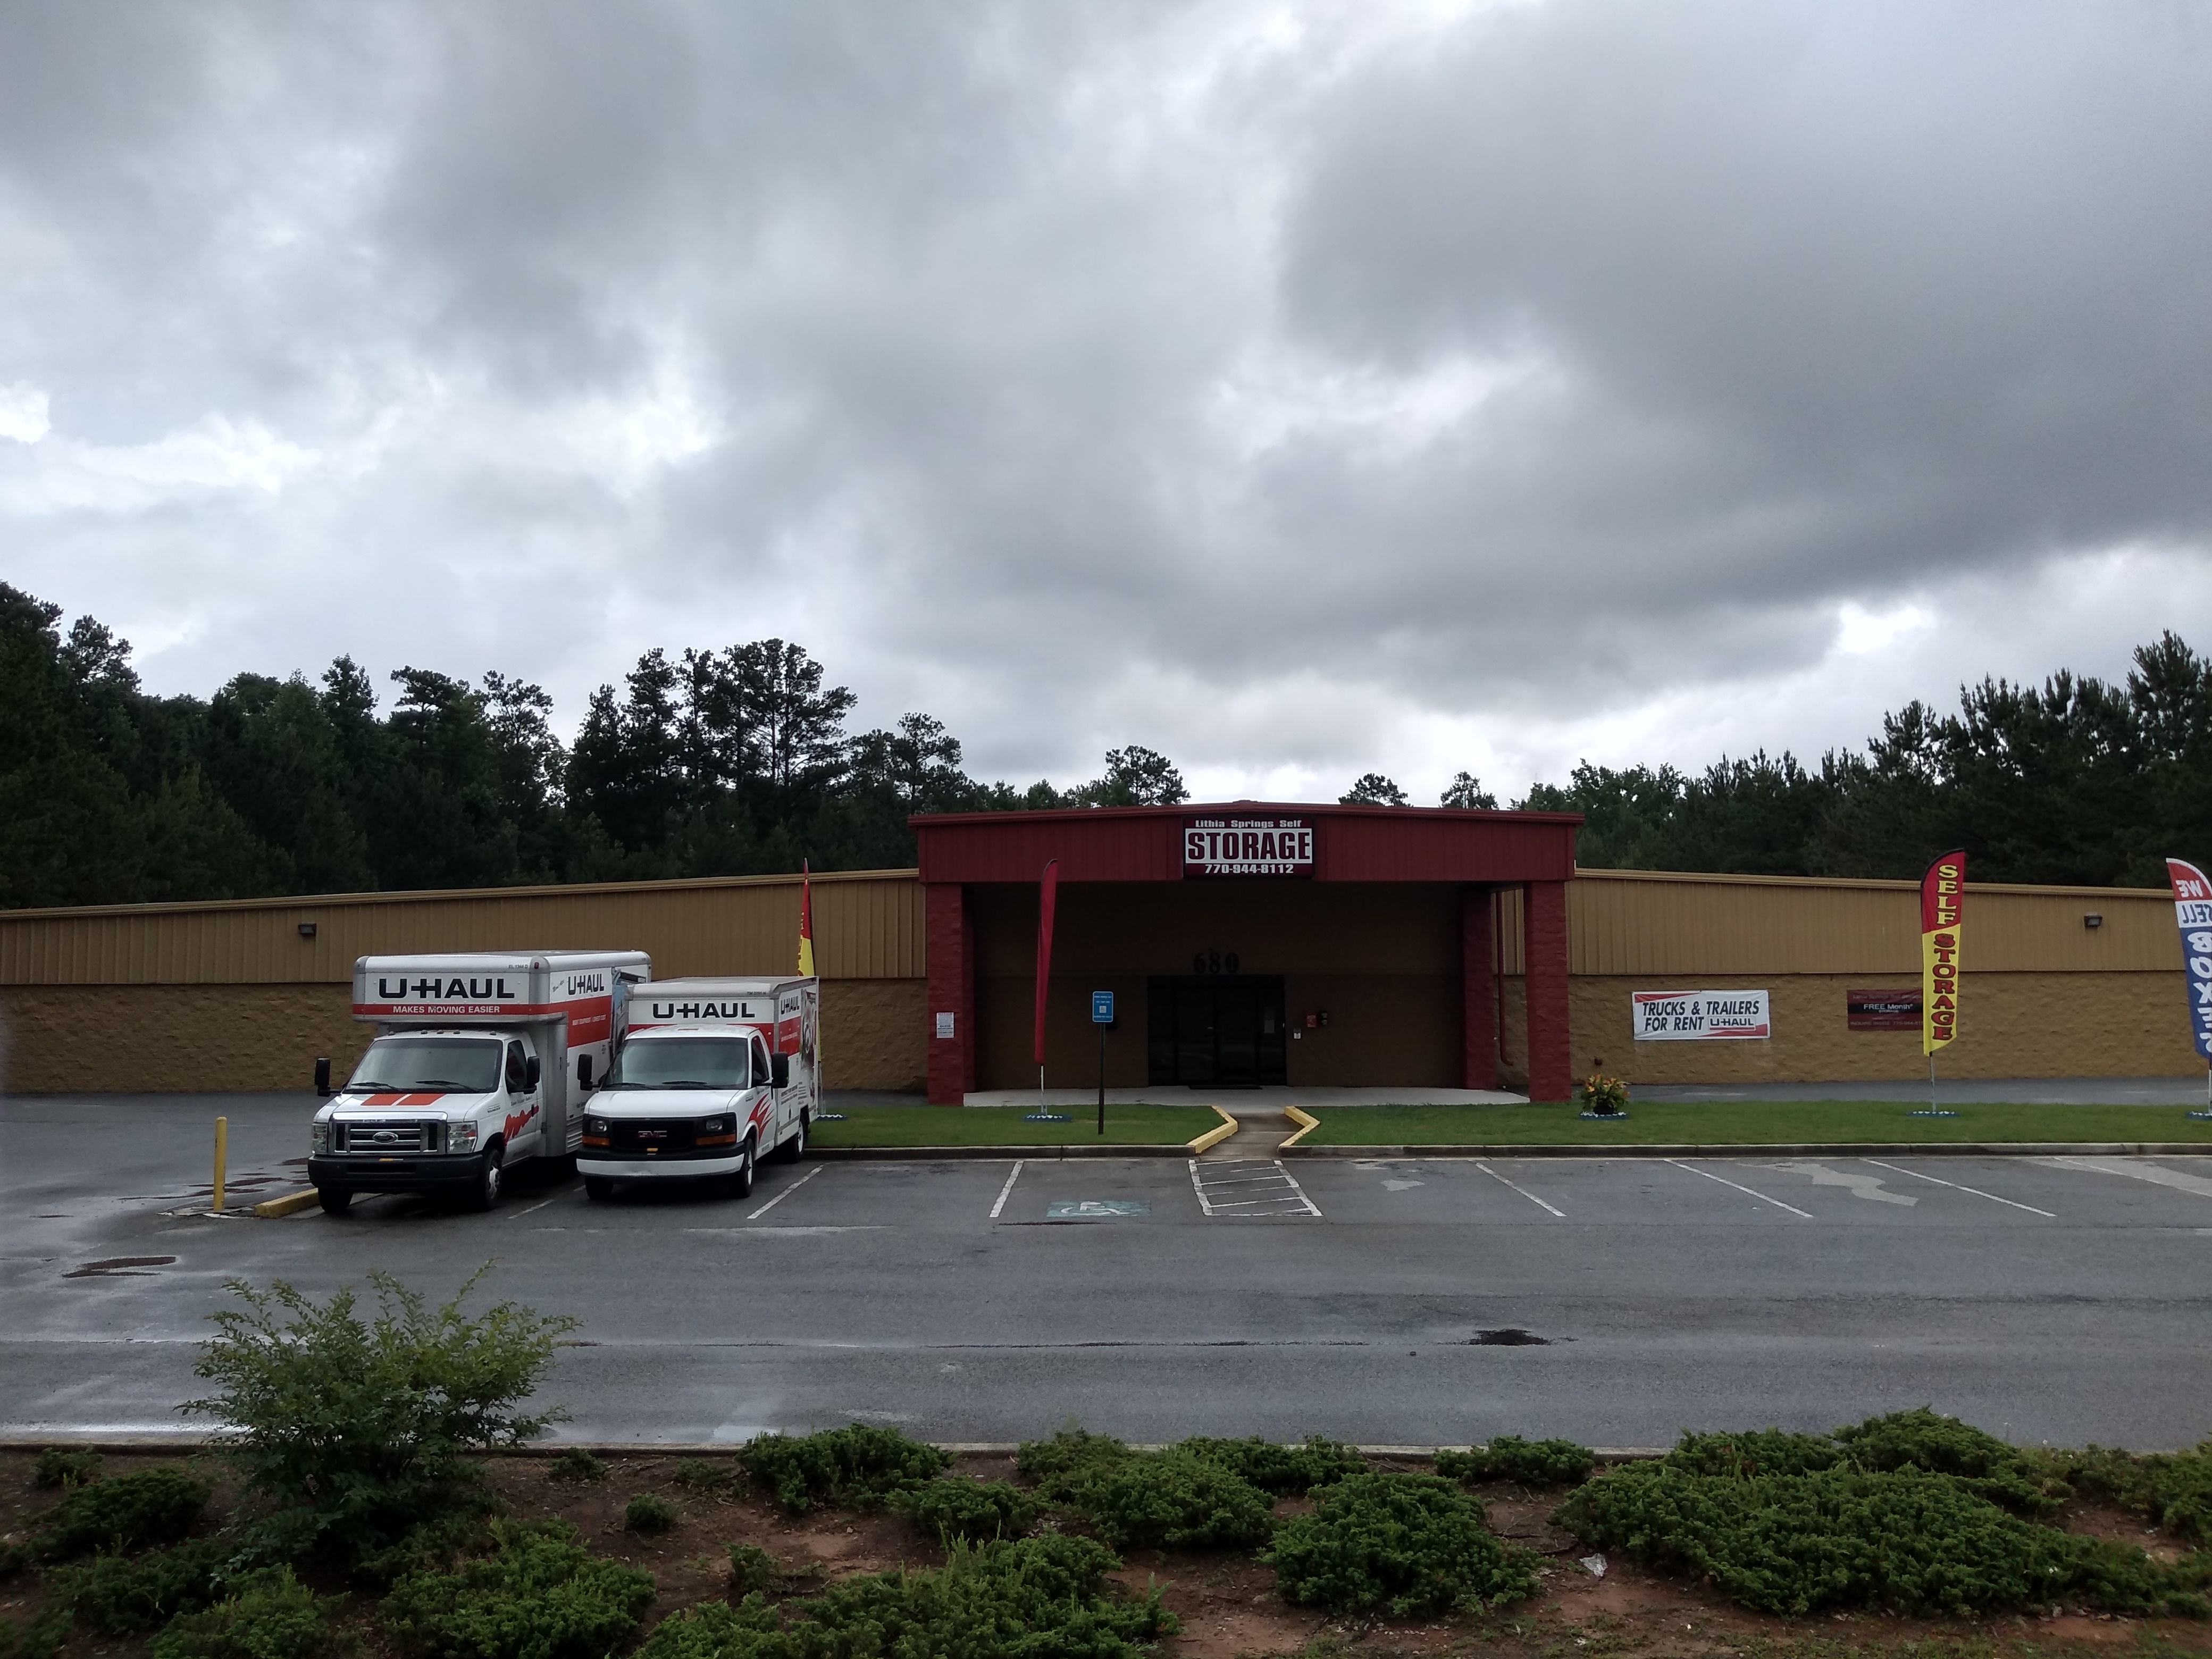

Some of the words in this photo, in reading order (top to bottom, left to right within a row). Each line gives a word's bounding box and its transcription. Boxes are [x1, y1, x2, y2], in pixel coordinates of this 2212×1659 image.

[1230, 820, 1274, 829] Springs
[1188, 832, 1311, 860] STORAGE
[1204, 864, 1294, 874] 770-944-8112
[1937, 865, 1959, 925] SELF
[1194, 952, 1239, 974] 680
[379, 978, 515, 999] U-HAUL
[568, 973, 605, 995] U-HAUL
[1931, 933, 1956, 1041] STORAGE
[652, 1002, 755, 1019] U-HAUL
[780, 995, 800, 1015] U-HAUL
[1642, 1001, 1686, 1017] TRUCKS
[1691, 1000, 1701, 1015] &
[1706, 1000, 1760, 1015] TRAILERS
[1644, 1017, 1668, 1032] FOR
[1673, 1016, 1705, 1031] RENT
[1710, 1018, 1755, 1027] U-HAUL
